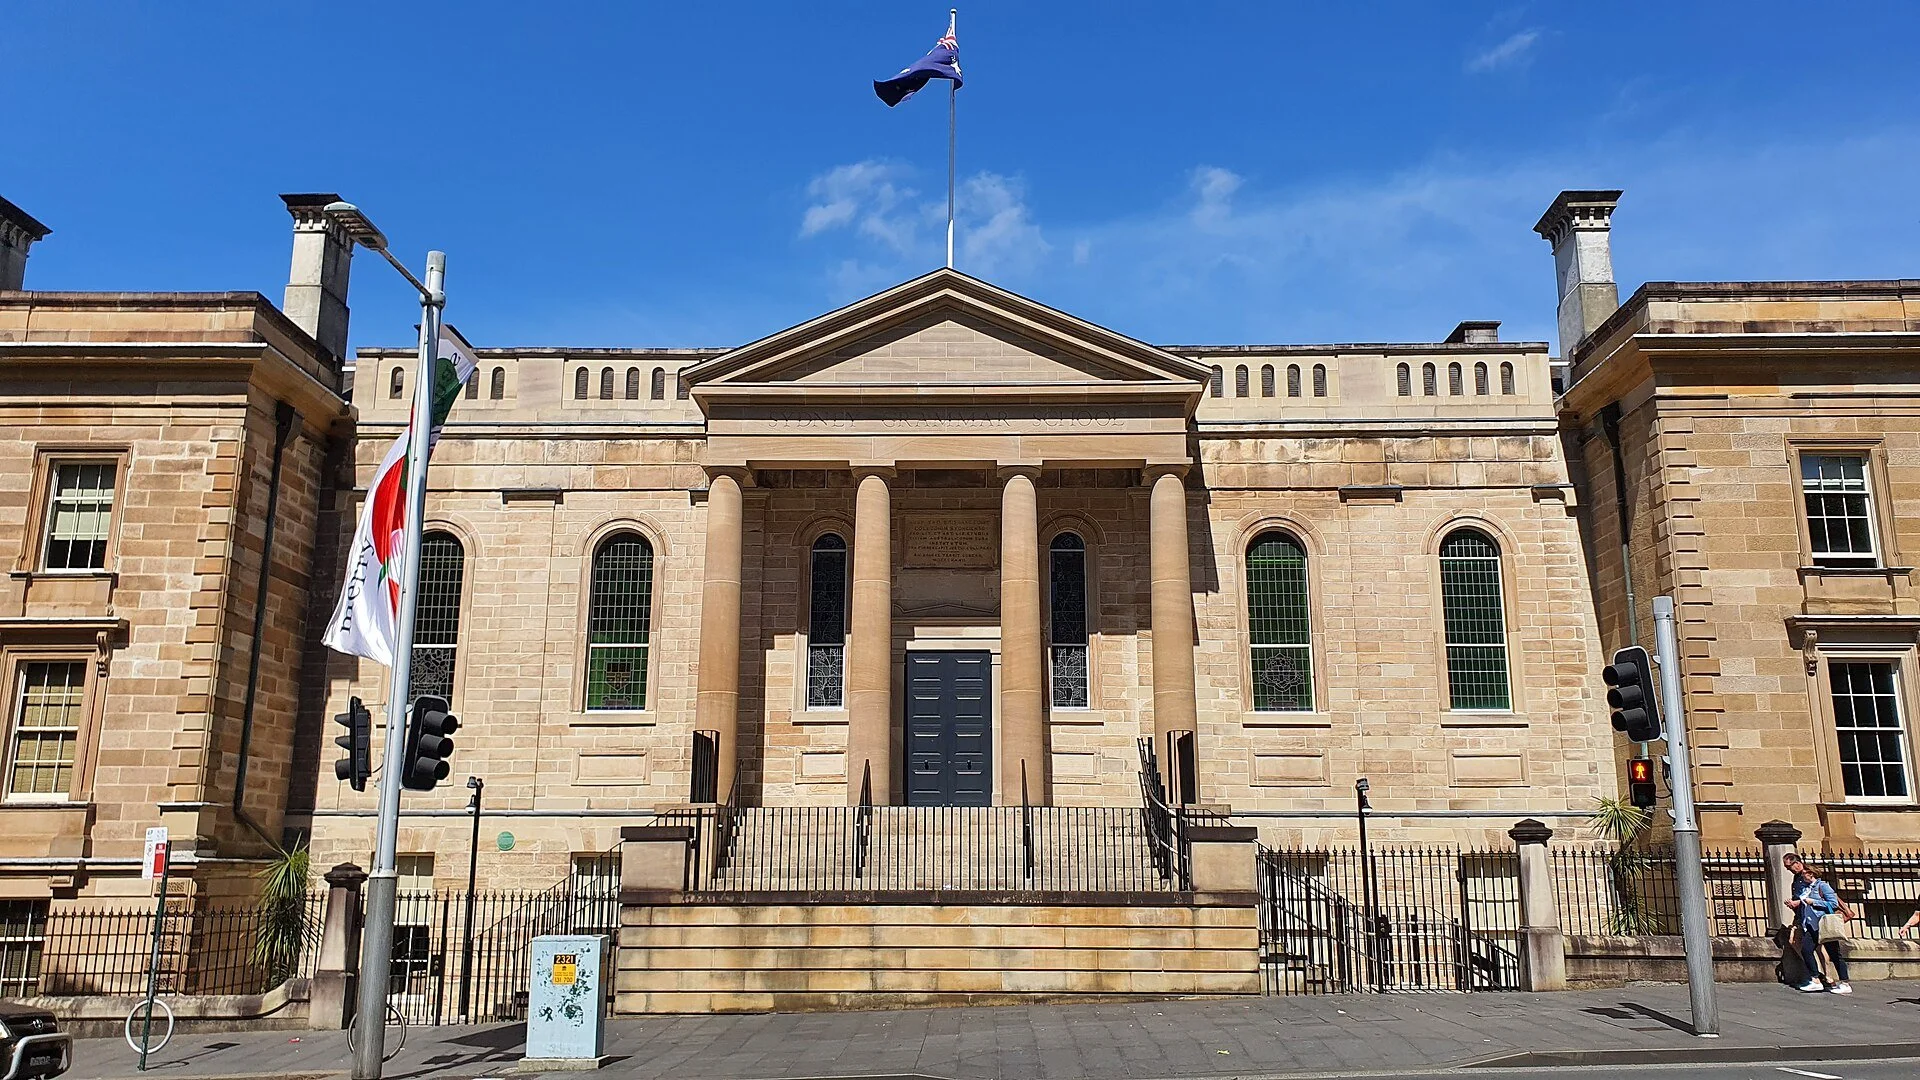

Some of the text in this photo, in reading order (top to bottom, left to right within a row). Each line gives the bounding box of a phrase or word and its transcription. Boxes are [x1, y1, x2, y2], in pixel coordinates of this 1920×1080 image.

[768, 410, 1125, 428] SYDNEY GRAMMAR SCHOOL
[340, 536, 374, 634] merry
